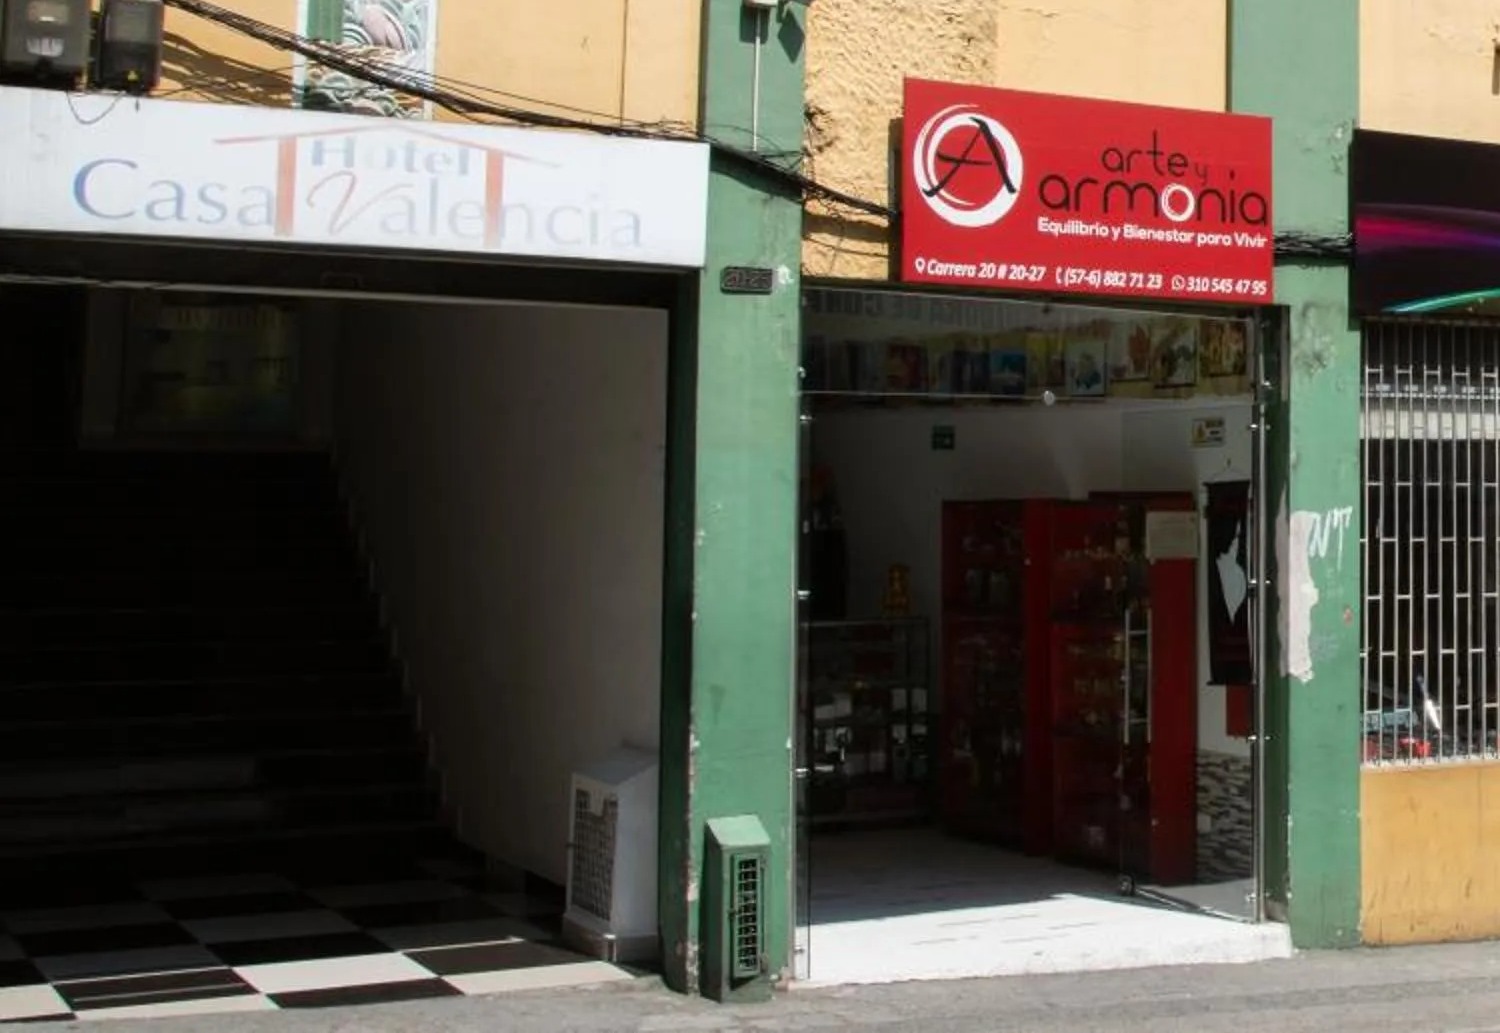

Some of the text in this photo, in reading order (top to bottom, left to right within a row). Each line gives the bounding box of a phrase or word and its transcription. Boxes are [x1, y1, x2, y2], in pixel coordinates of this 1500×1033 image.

[310, 135, 470, 177] Hotel
[1102, 129, 1209, 185] arte y
[72, 157, 643, 249] Casa Valencia
[1039, 170, 1267, 225] armonia
[1037, 217, 1267, 248] Equilibrio y Bienestar para Vivir
[927, 259, 976, 277] Carrera
[978, 262, 996, 279] 20
[1009, 264, 1046, 281] 20-27
[1064, 268, 1101, 289] (57-6)
[1129, 273, 1144, 288] 71
[1187, 276, 1209, 292] 310
